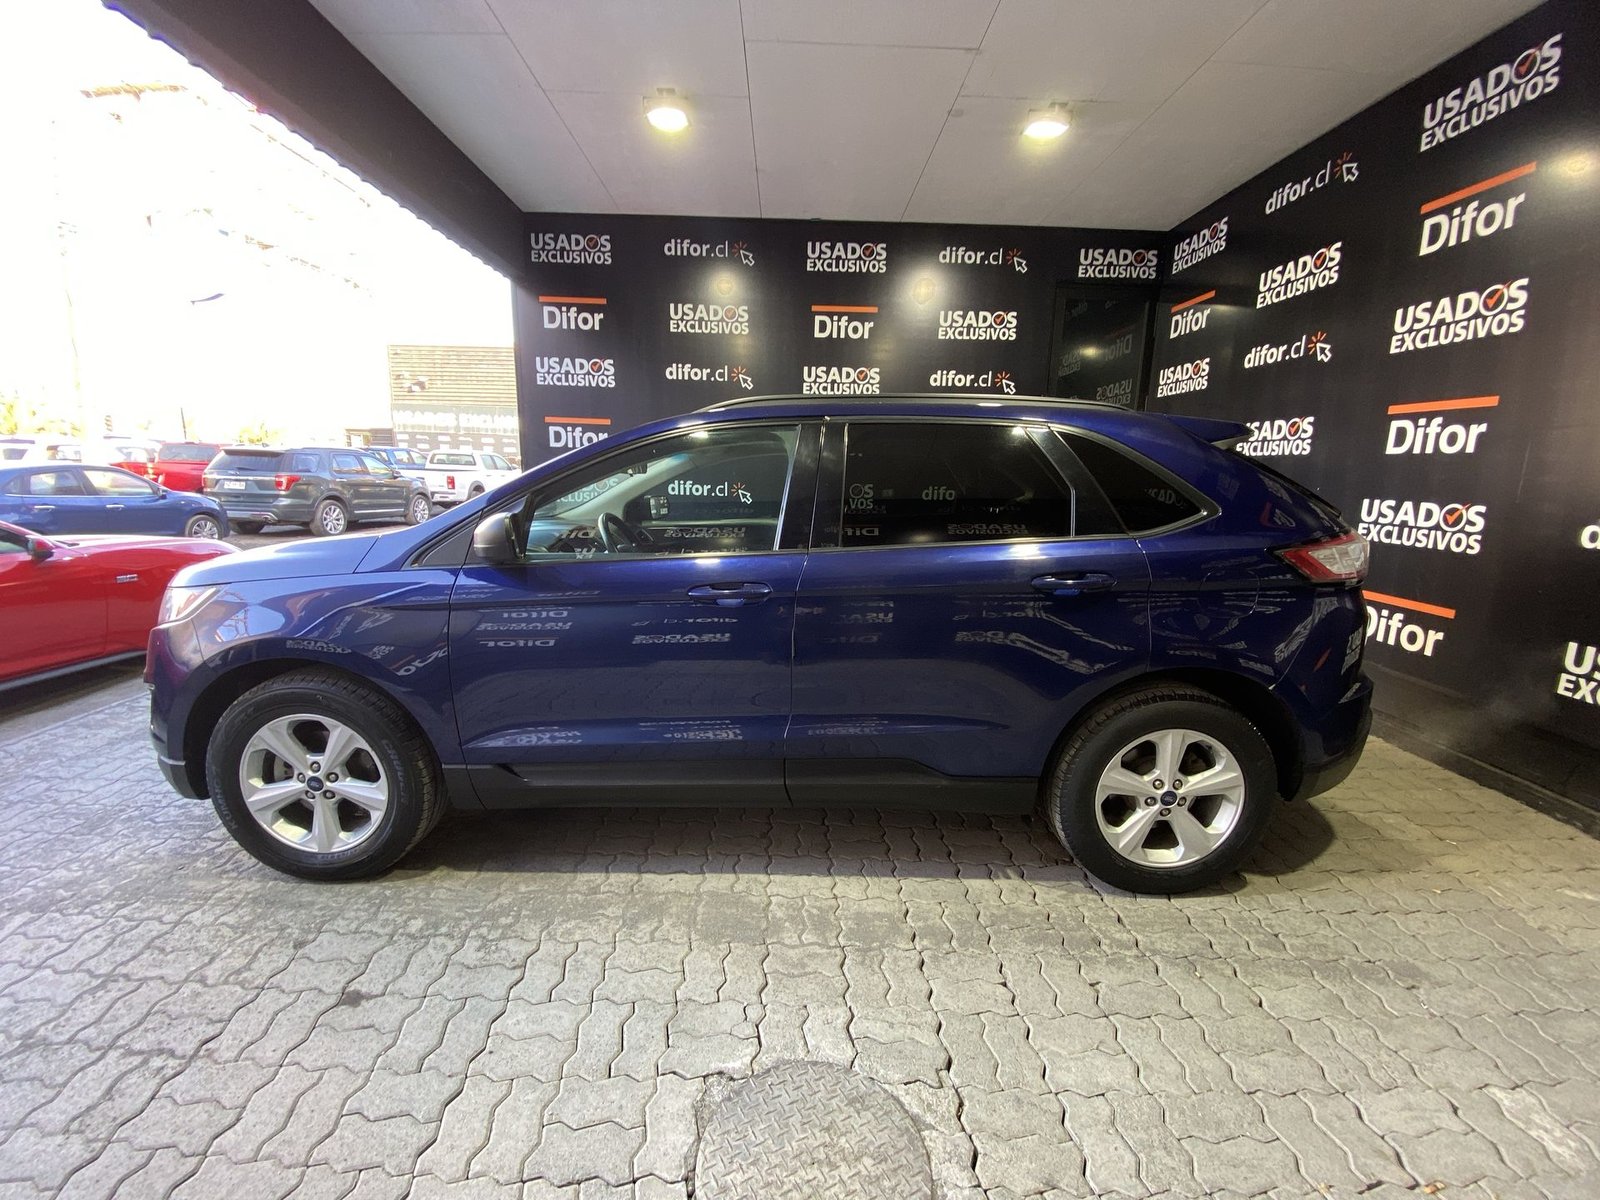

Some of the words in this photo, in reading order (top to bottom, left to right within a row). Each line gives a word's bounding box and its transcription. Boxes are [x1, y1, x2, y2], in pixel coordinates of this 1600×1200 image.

[1423, 33, 1563, 130] USADOS
[1420, 66, 1559, 152] EXCLUSIVOS
[1265, 160, 1331, 215] difor.cl
[1419, 192, 1526, 257] Difor
[530, 233, 611, 252] USADOS
[663, 238, 729, 258] difor.cl
[1174, 216, 1229, 262] USADOS
[530, 250, 612, 265] EXCLUSIVOS
[806, 241, 887, 261] USADOS
[938, 246, 1004, 265] difor.cl
[1079, 248, 1158, 267] USADOS
[1172, 236, 1227, 274] EXCLUSIVOS
[806, 258, 887, 274] EXCLUSIVOS
[1077, 264, 1157, 279] EXCLUSIVOS
[1259, 241, 1343, 293] USADOS
[1256, 265, 1340, 309] EXCLUSIVOS
[669, 303, 749, 322] USADOS
[1393, 277, 1529, 334] USADOS
[543, 305, 604, 331] Difor
[669, 319, 749, 335] EXCLUSIVOS
[813, 315, 875, 339] Difor
[939, 310, 1018, 329] USADOS
[1169, 307, 1211, 339] Difor
[937, 326, 1017, 341] EXCLUSIVOS
[1389, 309, 1525, 355] EXCLUSIVOS
[1244, 334, 1306, 369] difor.cl
[535, 356, 615, 376] USADOS
[665, 363, 728, 382] difor.cl
[803, 366, 880, 384] USADOS
[1159, 357, 1210, 385] USADOS
[536, 373, 616, 388] EXCLUSIVOS
[802, 382, 880, 395] EXCLUSIVOS
[929, 370, 992, 388] difor.cl
[1157, 375, 1209, 398] EXCLUSIVOS
[1246, 416, 1315, 442] SADOS
[1385, 416, 1488, 455] Difor
[1236, 439, 1312, 457] EXCLUSIVOS
[668, 480, 728, 497] difor.cl
[922, 486, 956, 502] difo
[1360, 498, 1487, 533] USADOS
[1357, 522, 1482, 555] EXCLUSIVOS
